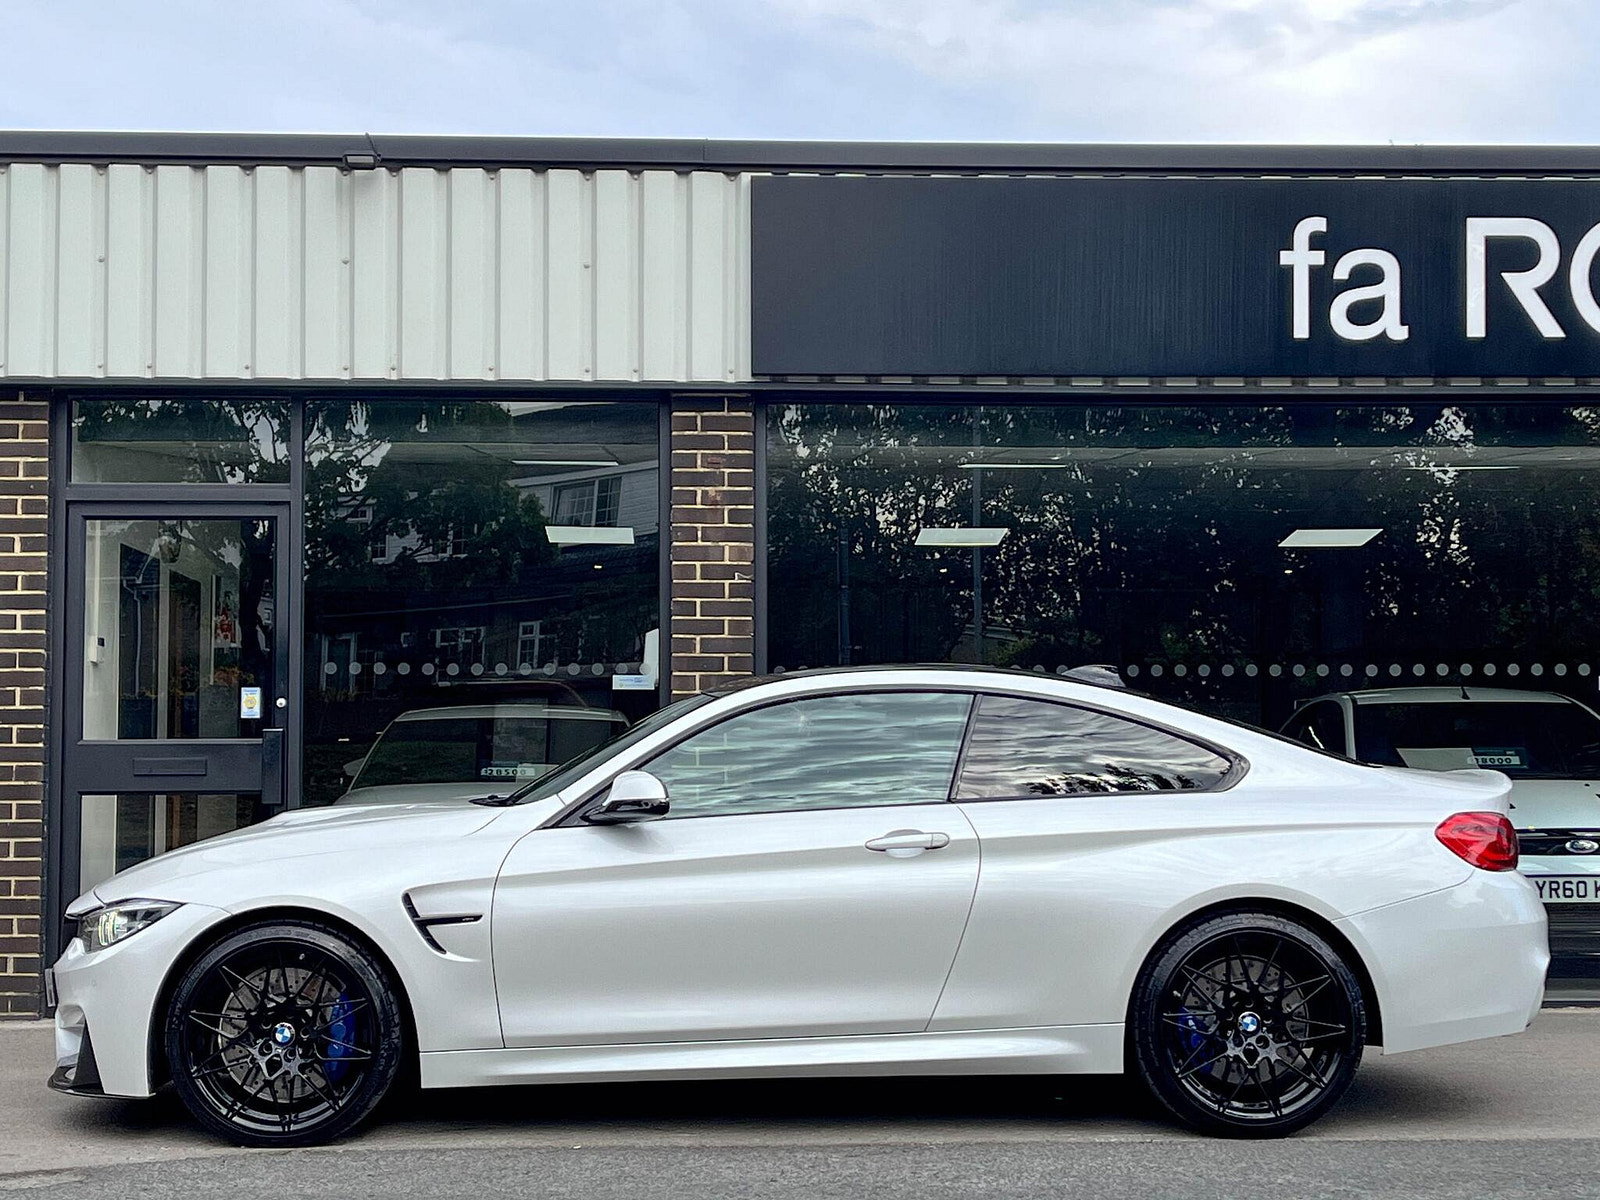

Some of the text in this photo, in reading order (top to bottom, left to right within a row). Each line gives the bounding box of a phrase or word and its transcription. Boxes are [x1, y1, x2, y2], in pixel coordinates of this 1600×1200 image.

[1279, 216, 1600, 341] fa R
[1535, 880, 1588, 899] YR60
